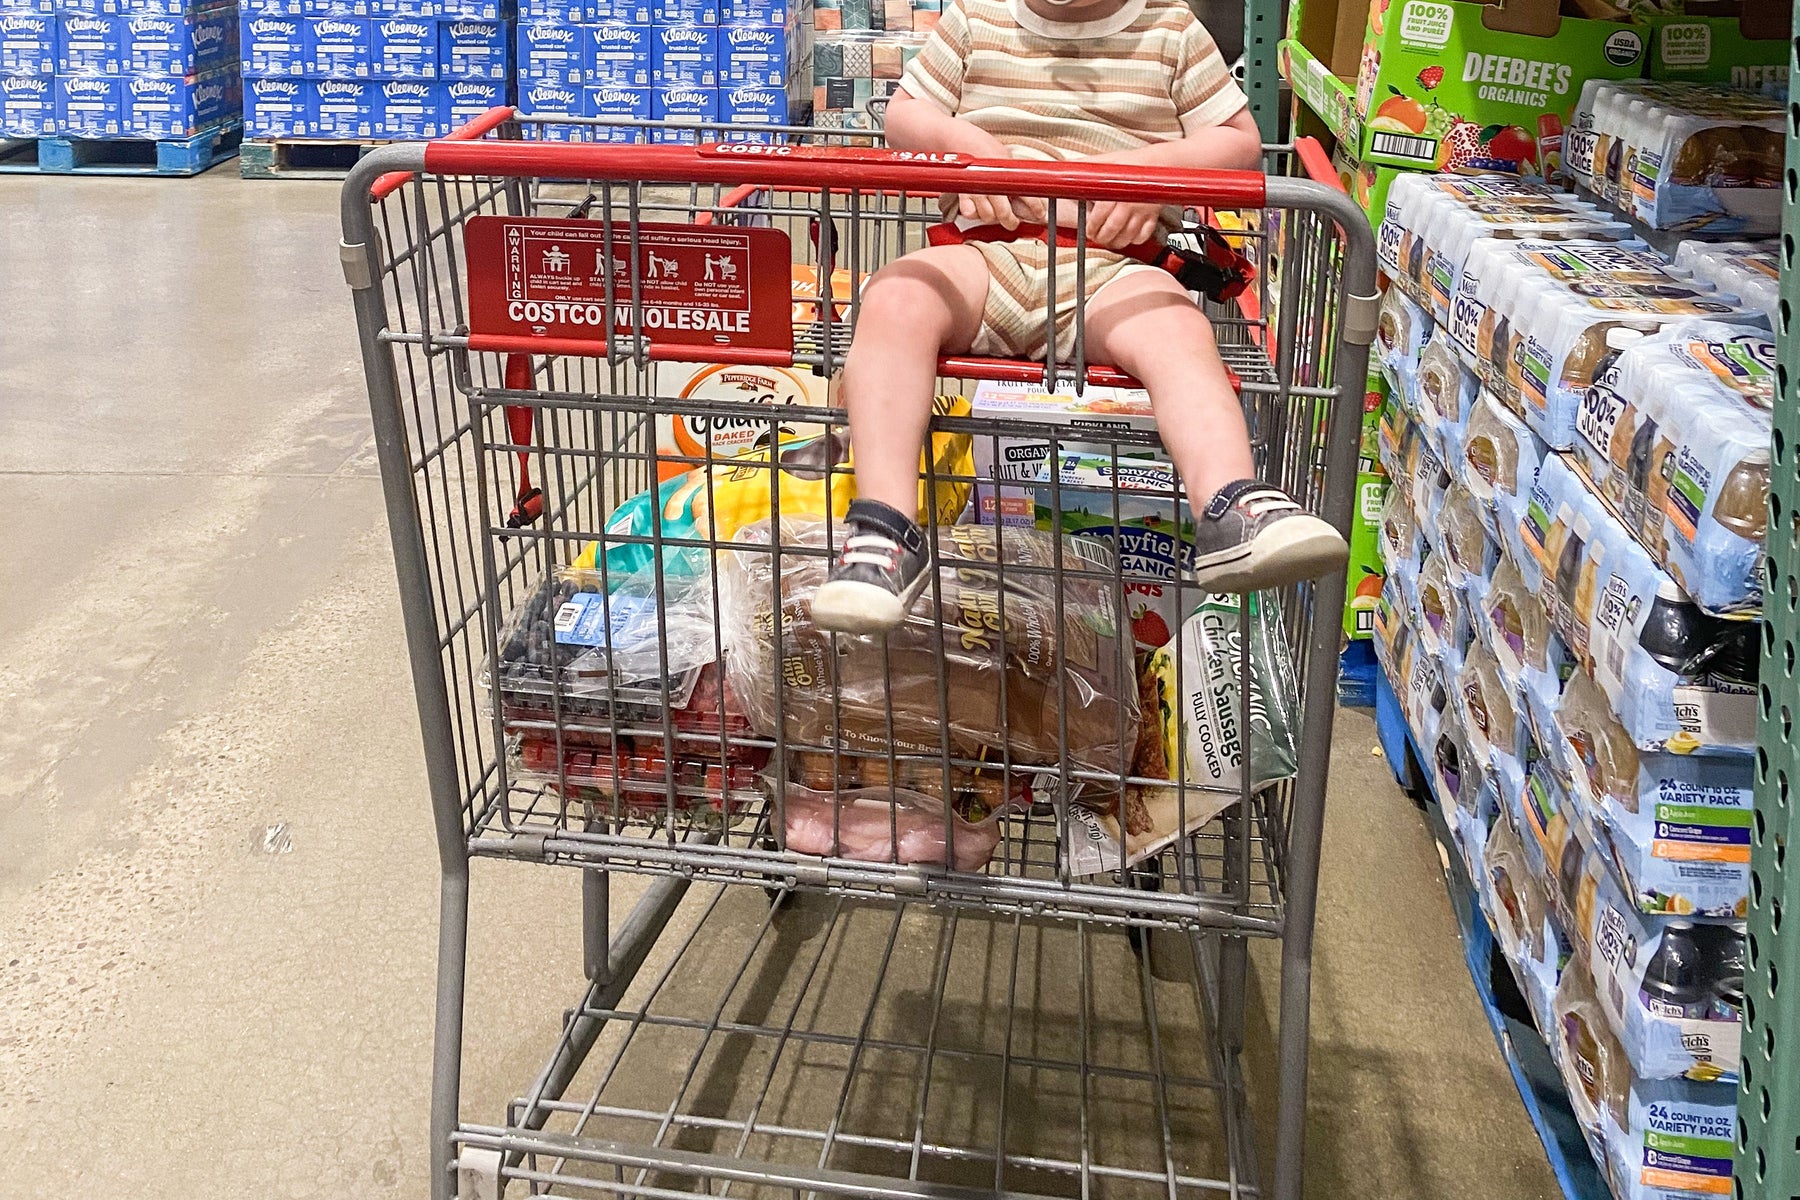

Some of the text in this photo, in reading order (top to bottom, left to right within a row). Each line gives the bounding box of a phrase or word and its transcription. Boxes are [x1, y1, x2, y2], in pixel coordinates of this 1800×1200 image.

[1409, 3, 1448, 20] 100%
[64, 17, 112, 35] Kleenex
[128, 17, 176, 35] Kleenex
[248, 19, 296, 36] Kleenex
[312, 19, 361, 37] Kleenex
[380, 20, 428, 38] Kleenex
[448, 21, 496, 40] Kleenex
[1407, 17, 1446, 28] FRUIT JUICE
[526, 26, 574, 44] Kleenex
[593, 27, 641, 44] Kleenex
[660, 28, 708, 46] Kleenex
[727, 27, 775, 45] Kleenex
[1614, 38, 1635, 49] USDA
[1667, 28, 1706, 41] 100%
[1462, 51, 1572, 95] DEEBEE'S
[1, 77, 49, 94] Kleenex
[63, 77, 111, 95] Kleenex
[128, 77, 177, 95] Kleenex
[251, 78, 300, 96] Kleenex
[316, 79, 364, 97] Kleenex
[381, 81, 430, 98] Kleenex
[447, 82, 495, 100] Kleenex
[528, 87, 576, 105] Kleenex
[593, 89, 641, 107] Kleenex
[660, 89, 709, 107] Kleenex
[728, 89, 777, 106] Kleenex
[1478, 85, 1548, 108] ORGANICS
[1570, 133, 1594, 155] 100%
[1571, 153, 1592, 171] JUICE
[1381, 222, 1400, 246] 100%
[1380, 243, 1398, 265] JUICE
[508, 237, 522, 298] WARNING
[508, 302, 602, 326] COSTCO
[1454, 297, 1478, 327] 100%
[1453, 320, 1477, 350] JUICE
[757, 376, 773, 387] FARM
[1583, 388, 1617, 426] 100%
[714, 430, 755, 441] BAKED
[1581, 412, 1609, 453] JUICE
[1120, 557, 1176, 579] GANIC
[1708, 679, 1757, 695] Welch's
[1191, 691, 1208, 722] FULLY
[1673, 705, 1699, 717] lch's
[1213, 682, 1242, 768] Sausage
[844, 729, 857, 739] To
[859, 732, 888, 745] Know
[918, 743, 944, 753] Brea
[1198, 723, 1222, 779] COOKED
[1660, 778, 1741, 795] 24 COUNT 10 OZ.
[1660, 792, 1741, 806] VARIETY PACK
[1660, 806, 1670, 819] 8
[1659, 823, 1669, 837] 8
[1682, 1035, 1709, 1047] elch's
[1649, 1104, 1732, 1127] 24 COUNT 10 OZ.
[1649, 1117, 1732, 1139] VARIETY PACK
[1648, 1133, 1658, 1147] 8
[1647, 1150, 1658, 1165] 8
